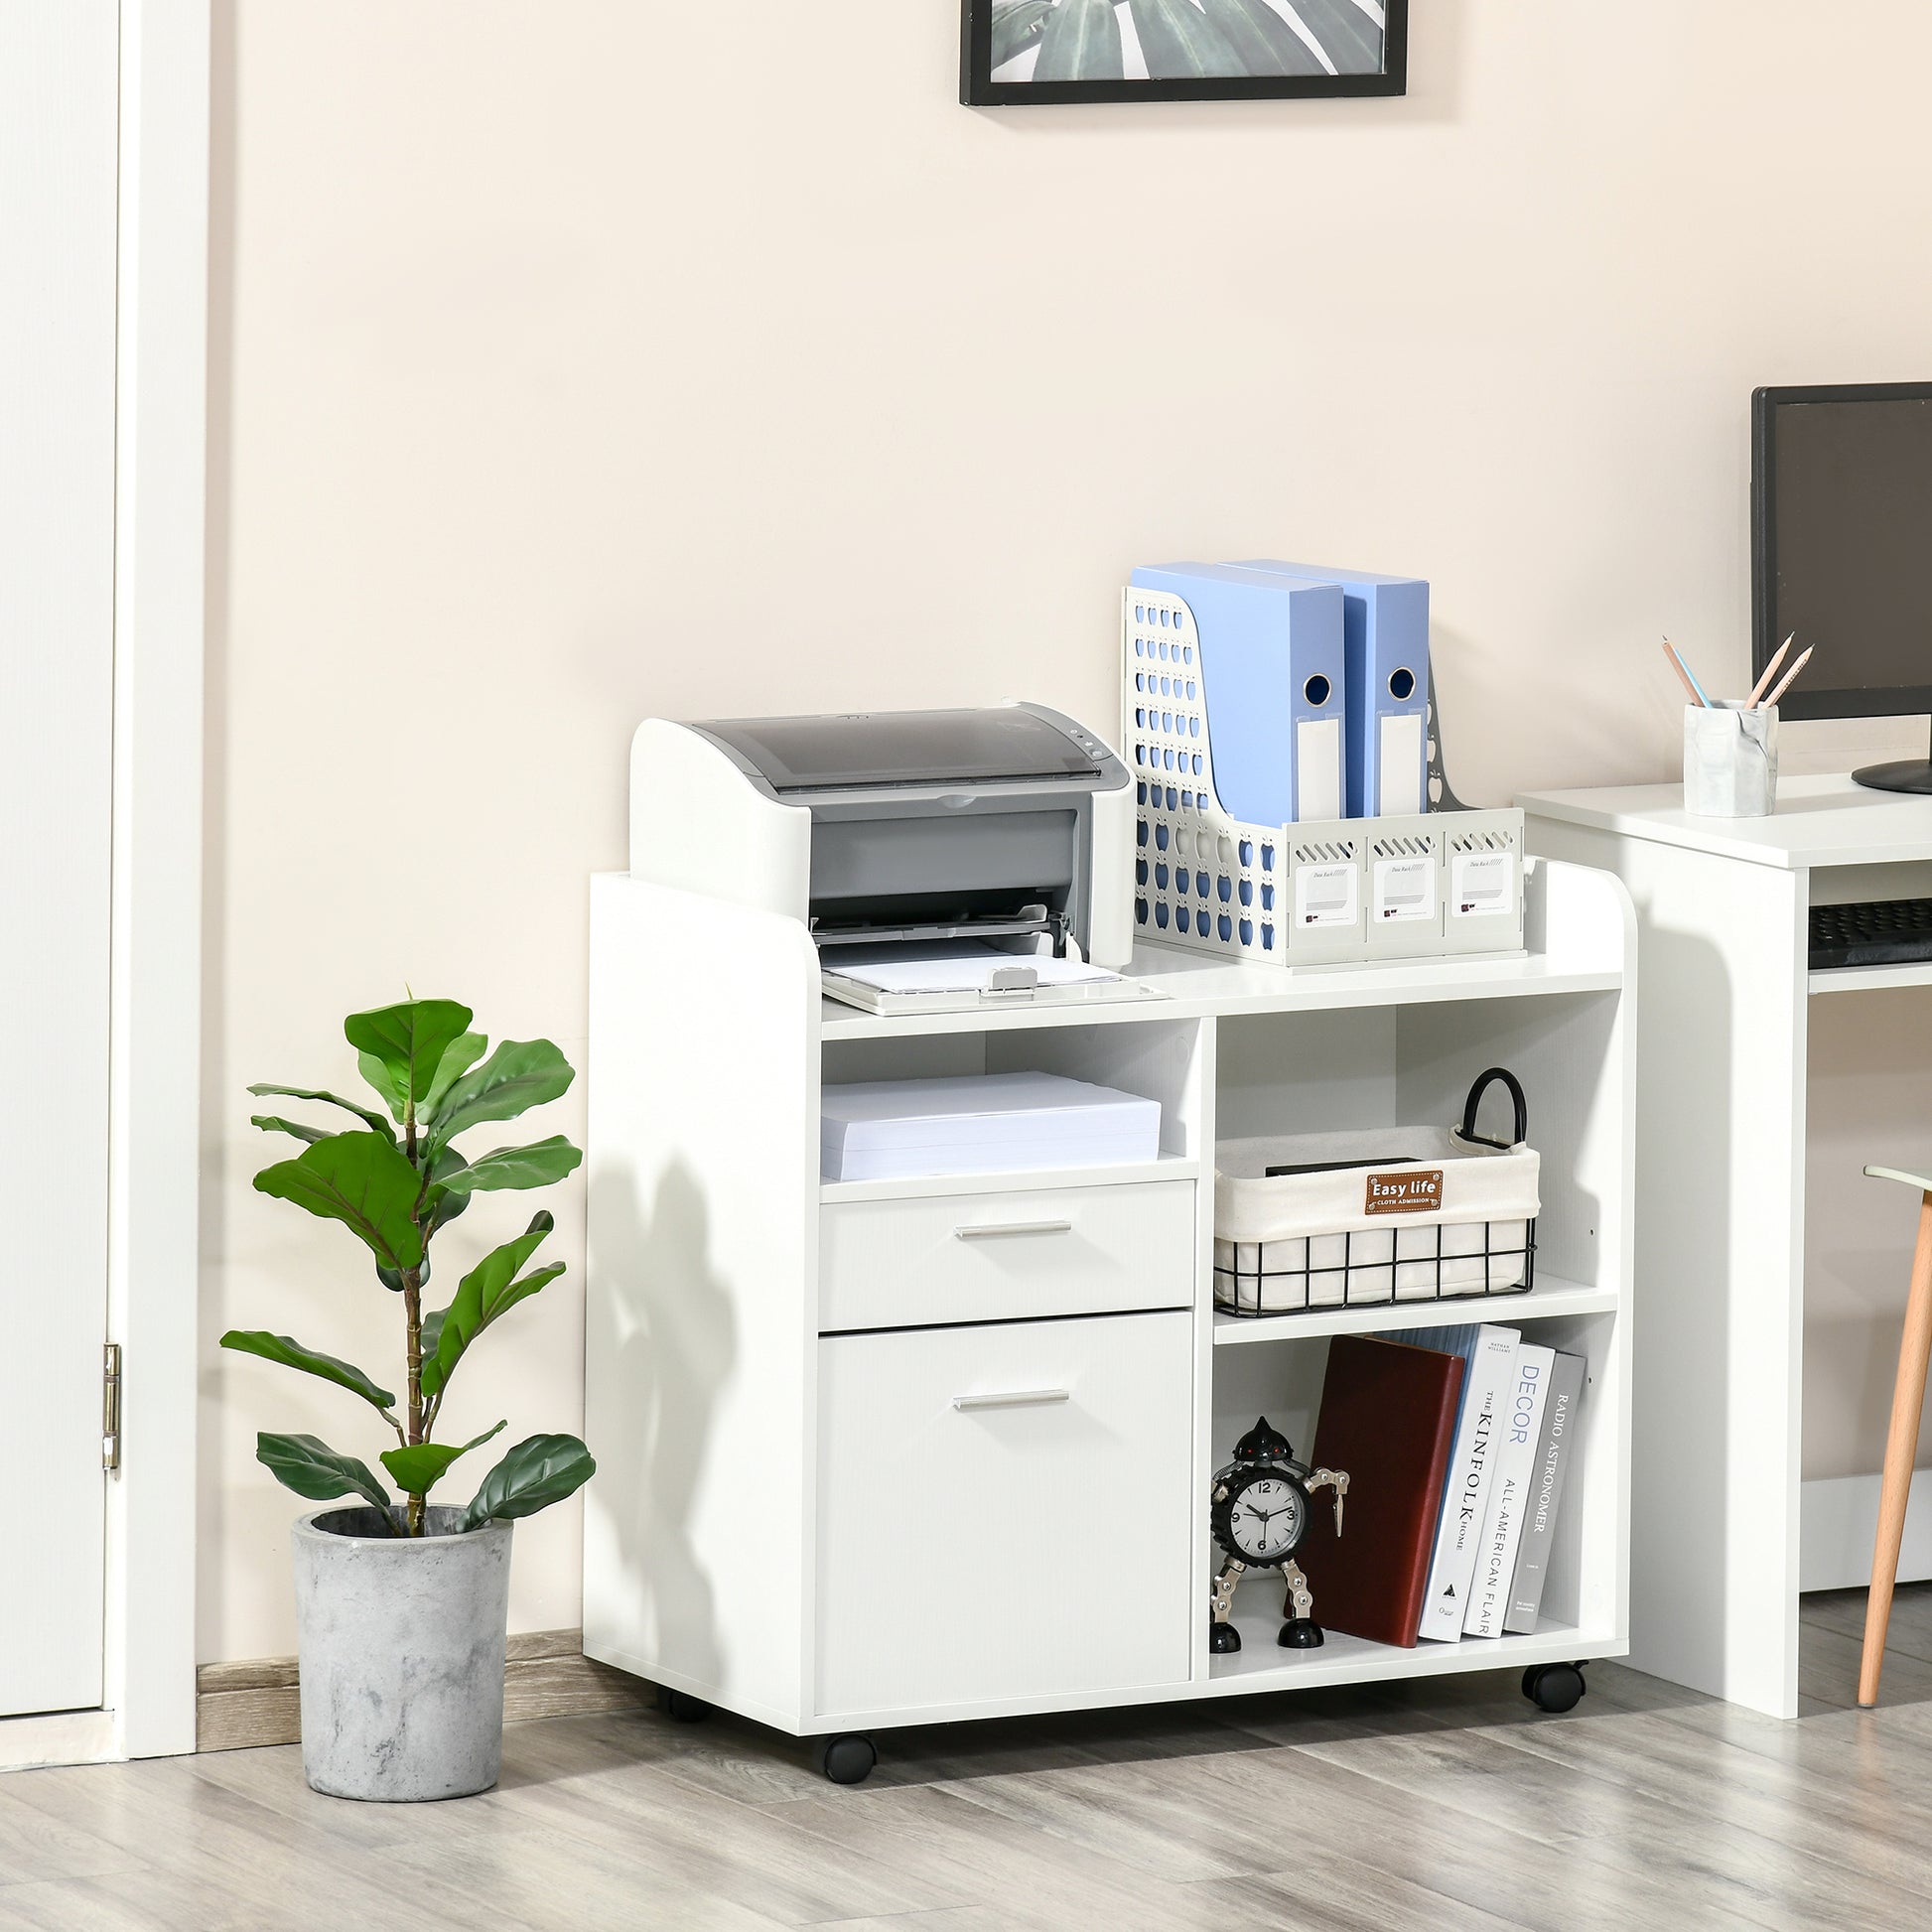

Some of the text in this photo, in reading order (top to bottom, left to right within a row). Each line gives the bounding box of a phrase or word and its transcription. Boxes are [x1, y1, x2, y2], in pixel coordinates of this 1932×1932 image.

[1373, 1180, 1436, 1197] Easy life
[1509, 1365, 1540, 1444] DECOR
[1456, 1390, 1494, 1551] THE KINFOLK HOME
[1534, 1393, 1570, 1533] RADIO ASTRONOMER
[1258, 1482, 1271, 1493] 12
[1232, 1512, 1240, 1523] 9
[1287, 1509, 1295, 1520] 3
[1257, 1540, 1266, 1550] 6
[1478, 1478, 1516, 1634] ALL-AMERICAN FLAIR
